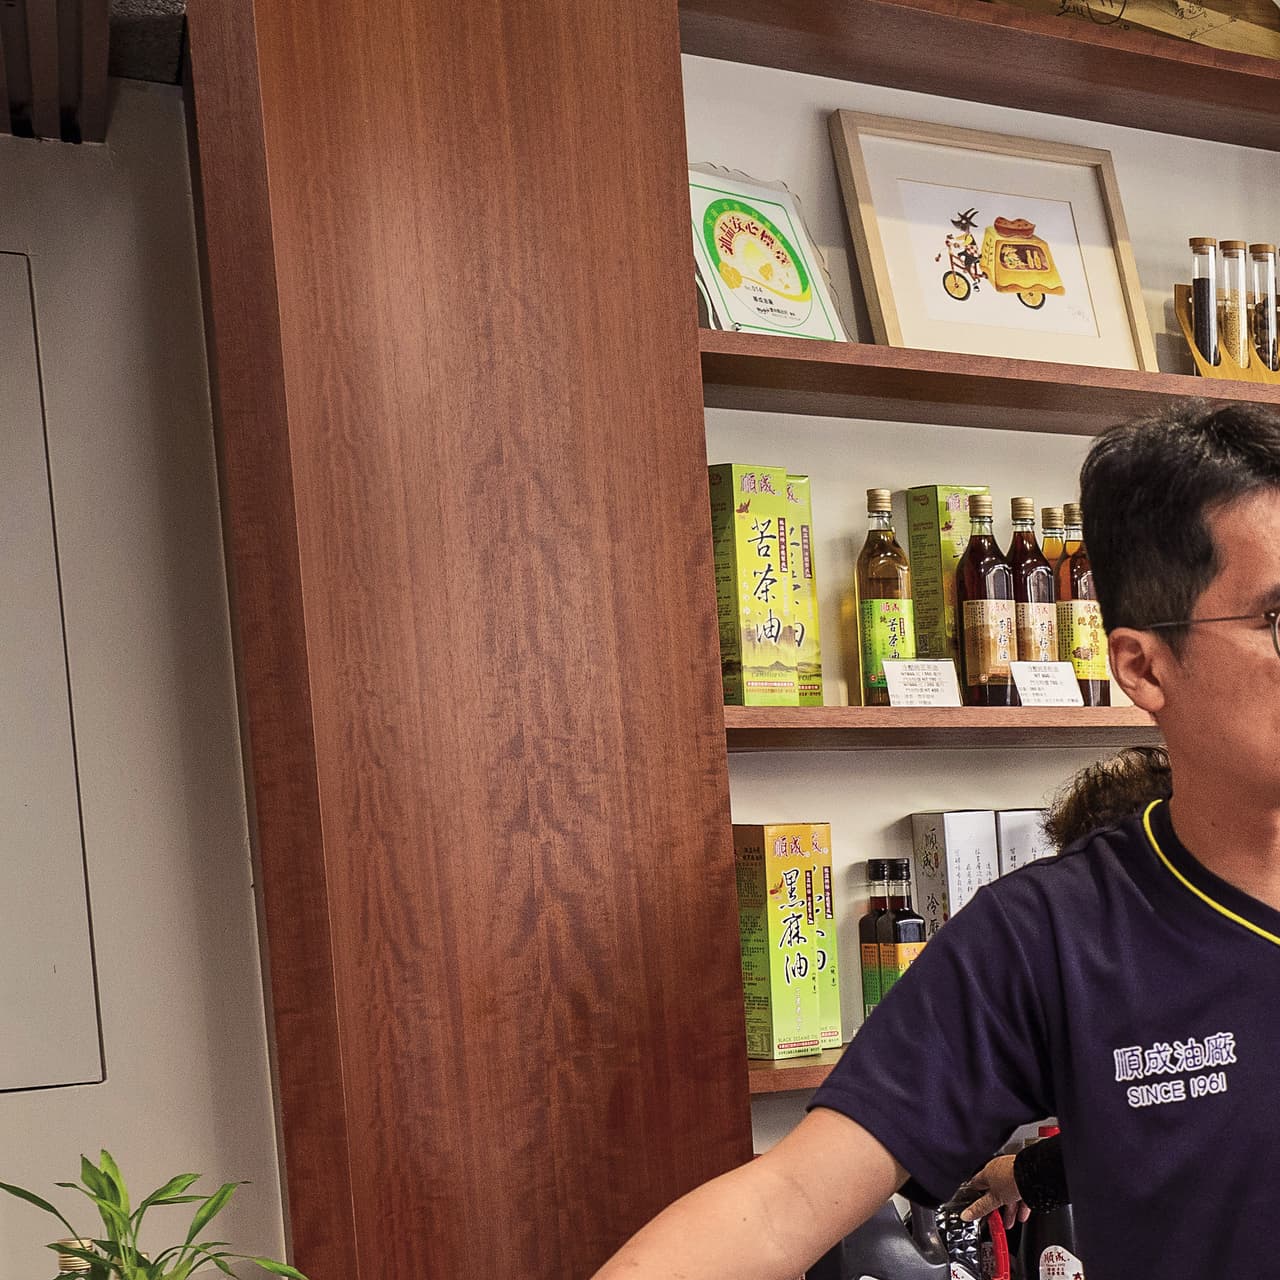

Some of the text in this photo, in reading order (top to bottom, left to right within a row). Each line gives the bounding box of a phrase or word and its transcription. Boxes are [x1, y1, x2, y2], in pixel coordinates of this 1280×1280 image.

[747, 517, 782, 644] 苦茶油
[778, 868, 808, 984] 黑麻油
[1113, 1032, 1238, 1082] 順成油廠
[1127, 1072, 1228, 1108] SINCE 1961
